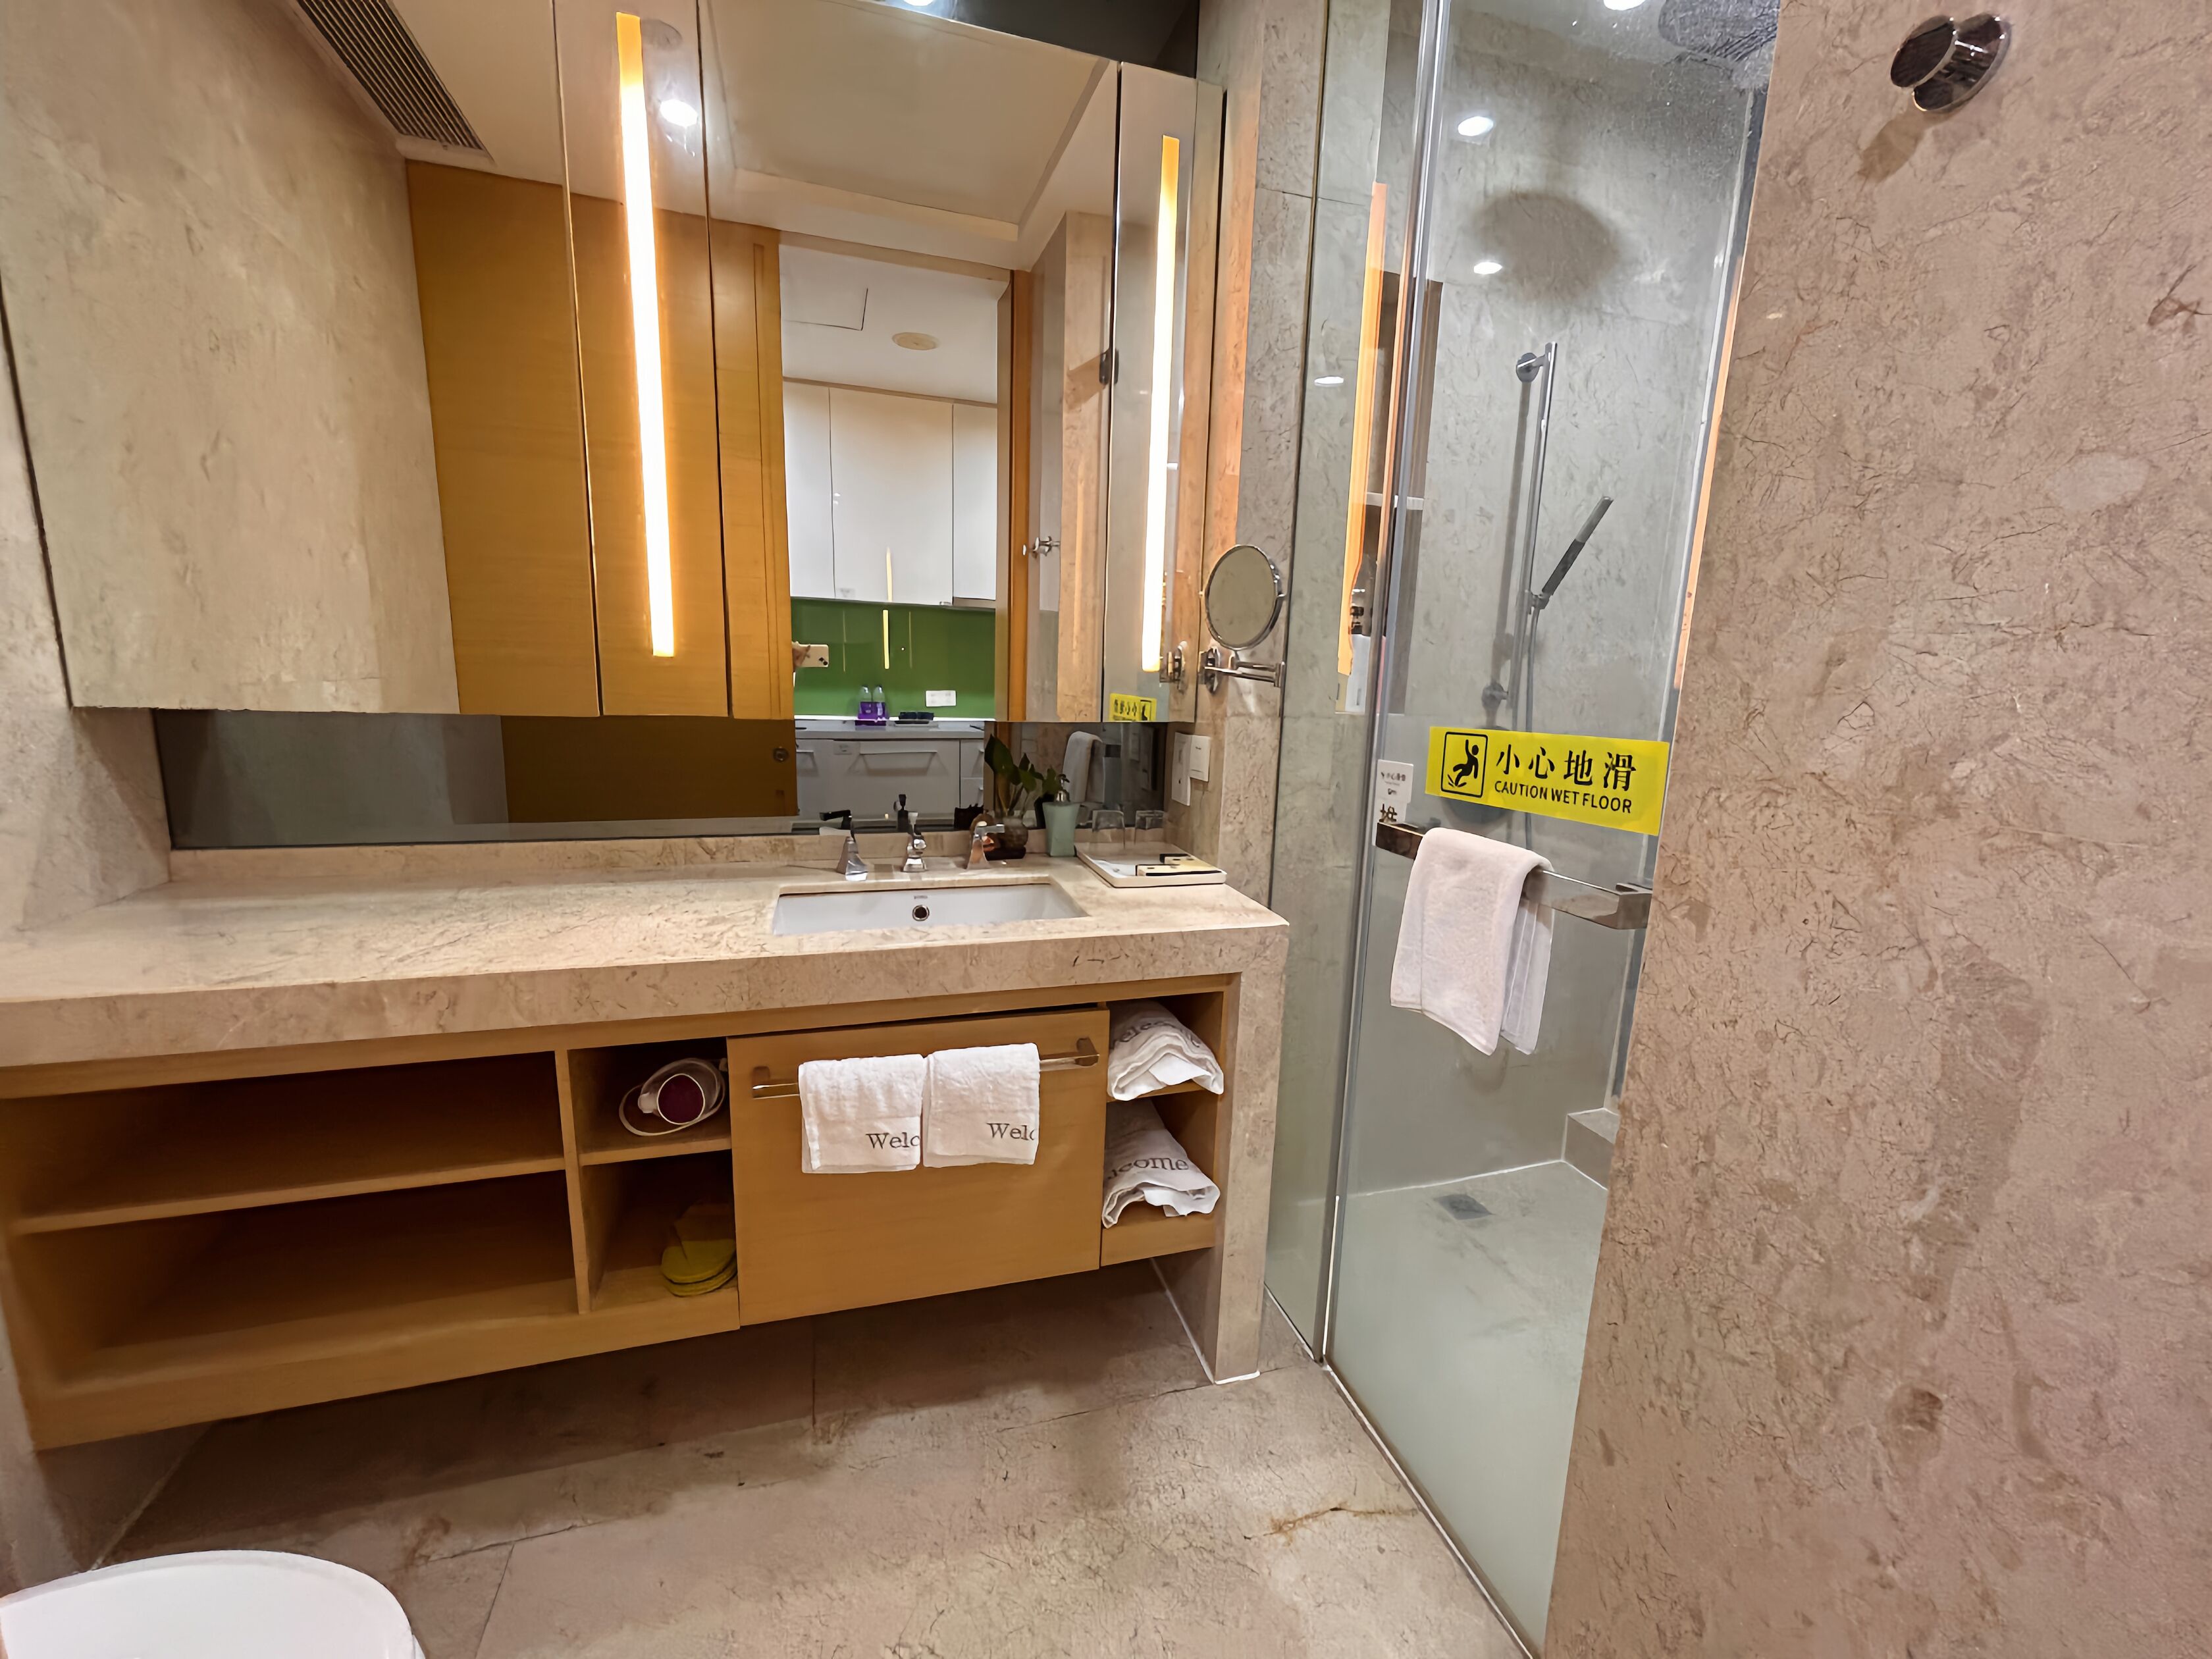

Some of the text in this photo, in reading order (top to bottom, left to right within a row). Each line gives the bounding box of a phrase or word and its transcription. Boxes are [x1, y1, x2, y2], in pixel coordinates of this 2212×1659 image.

[1496, 743, 1637, 791] 小心地滑
[1494, 780, 1632, 814] CAUTION WET FLOOR
[865, 1132, 920, 1149] Welc
